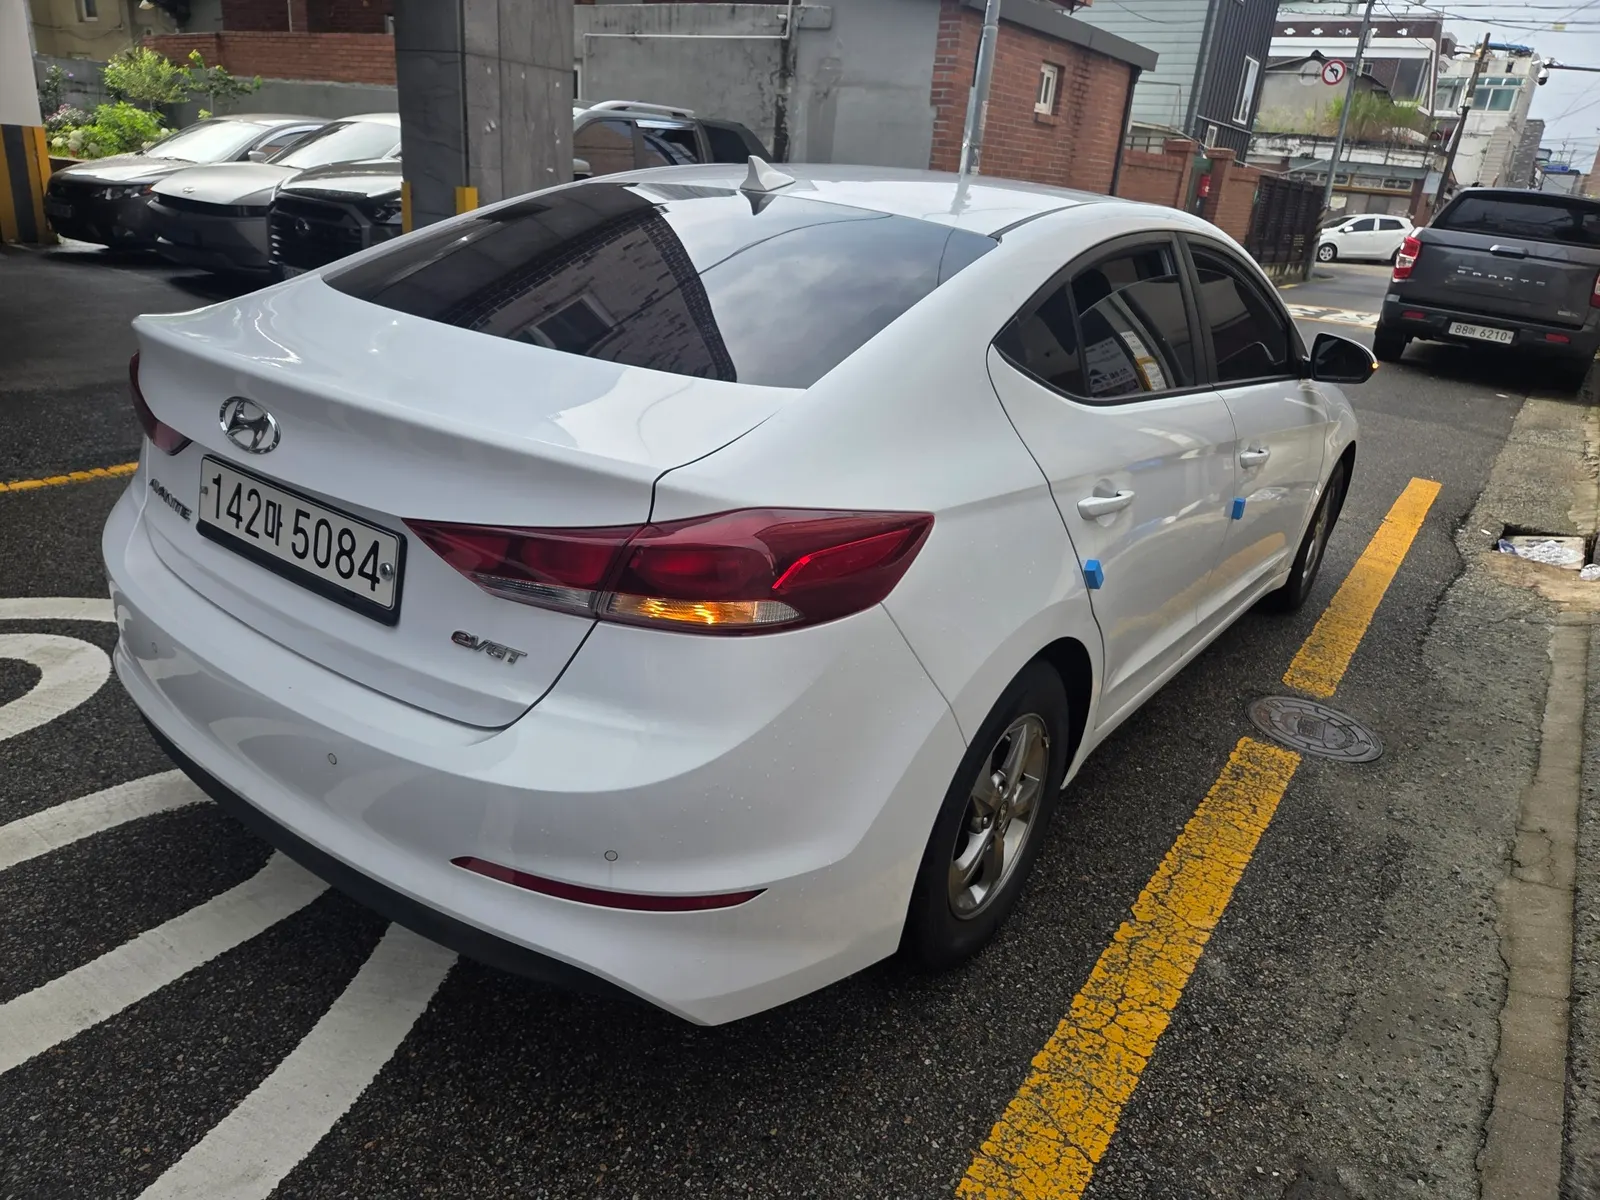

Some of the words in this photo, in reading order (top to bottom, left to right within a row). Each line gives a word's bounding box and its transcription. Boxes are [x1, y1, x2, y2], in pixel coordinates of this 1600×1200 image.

[1480, 329, 1507, 341] 6210
[212, 473, 283, 546] 142마
[291, 508, 380, 592] 5084
